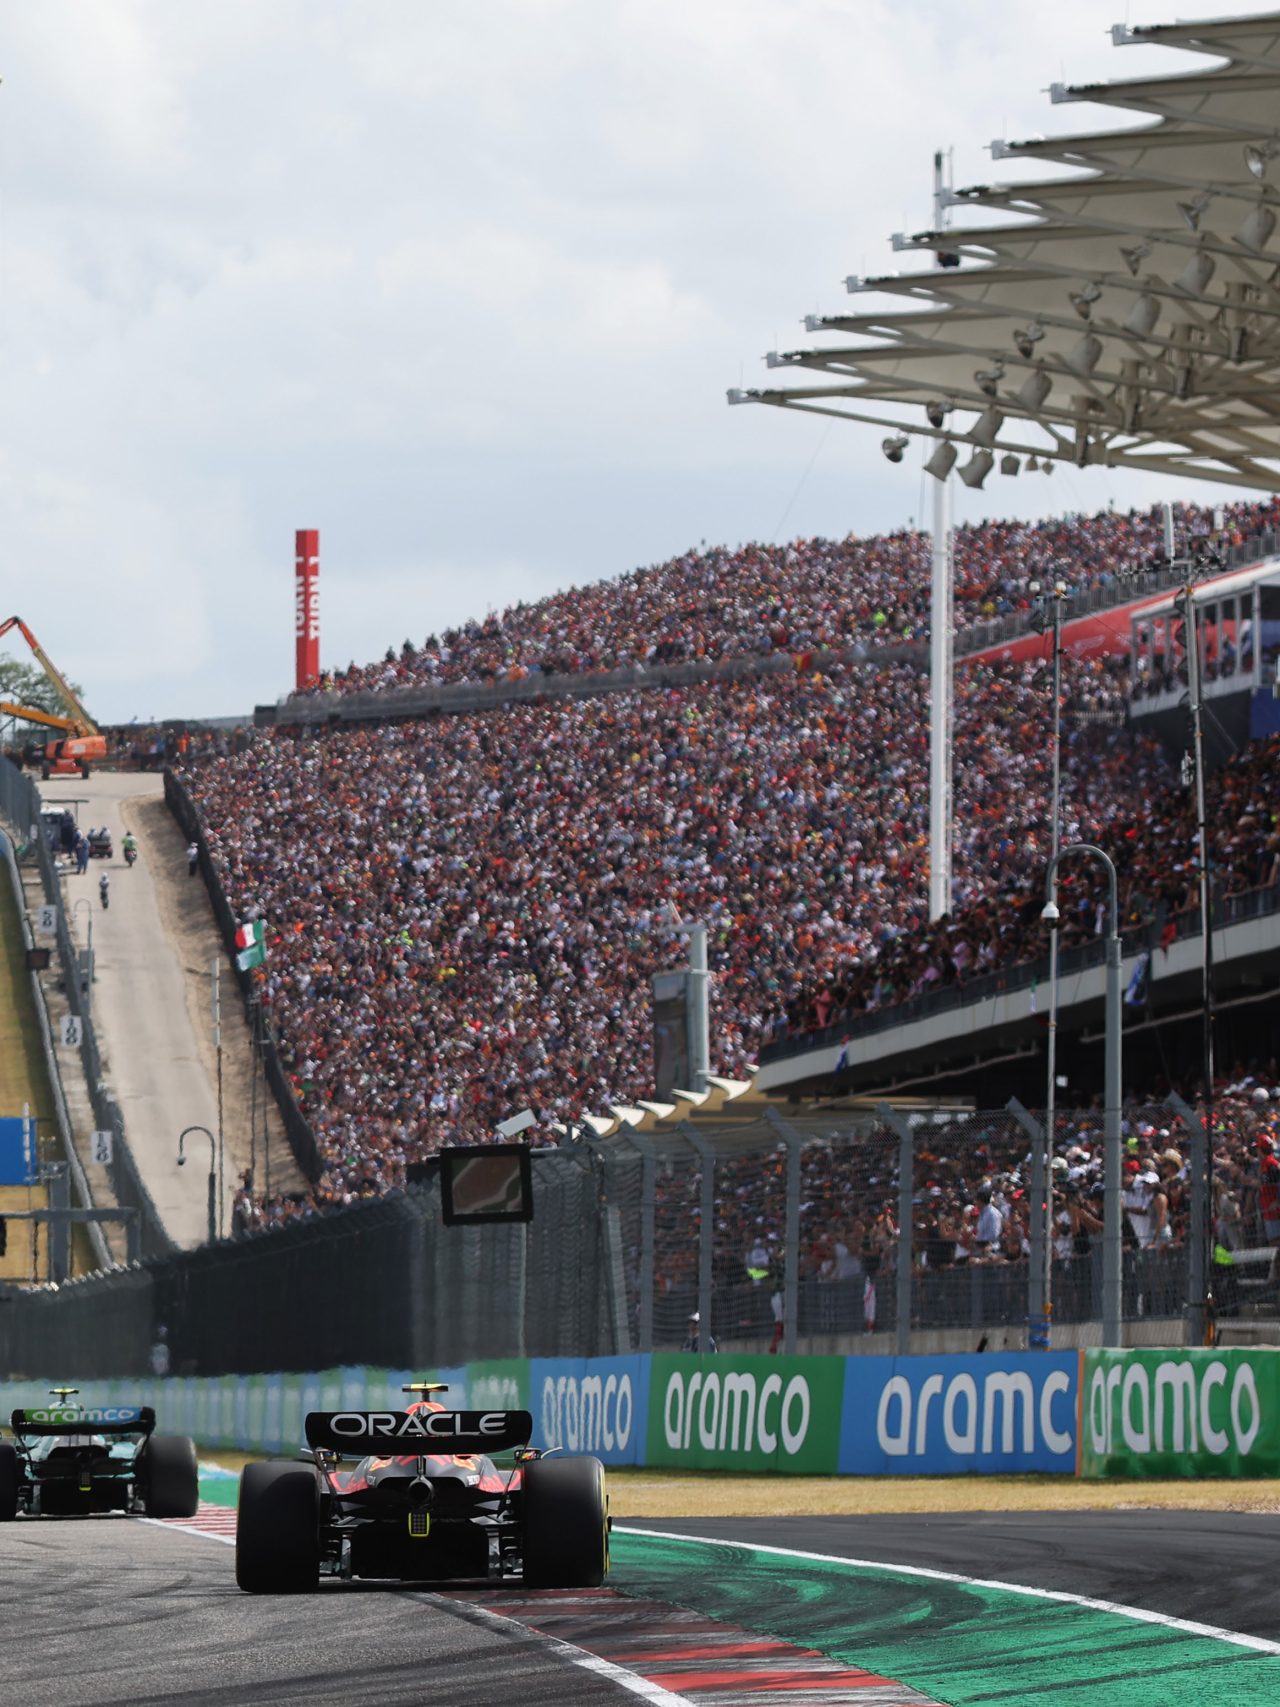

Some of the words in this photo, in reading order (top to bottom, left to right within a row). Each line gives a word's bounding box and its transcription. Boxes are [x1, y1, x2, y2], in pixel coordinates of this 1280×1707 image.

[31, 1407, 136, 1423] aramco
[329, 1412, 508, 1437] ORACLE
[543, 1373, 632, 1451] aramco
[664, 1371, 811, 1455] aramco
[876, 1370, 1078, 1456] aramc
[1090, 1360, 1260, 1455] aramco
